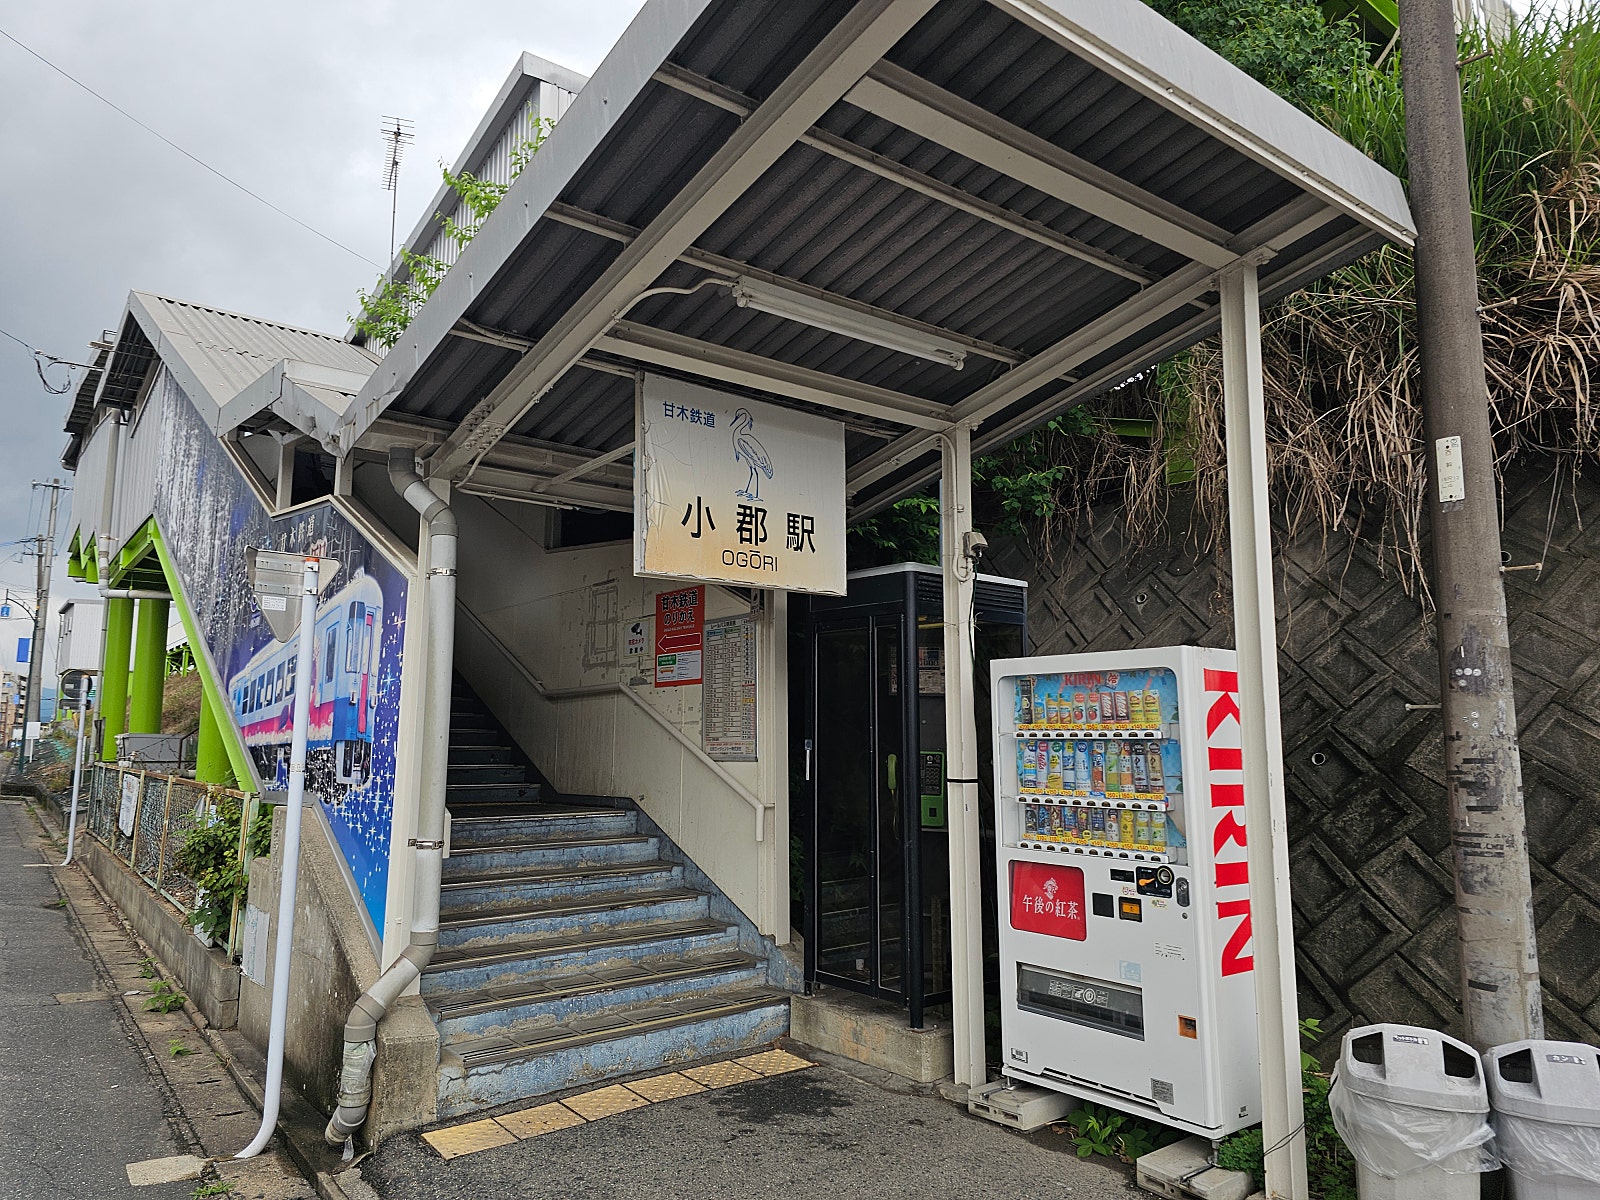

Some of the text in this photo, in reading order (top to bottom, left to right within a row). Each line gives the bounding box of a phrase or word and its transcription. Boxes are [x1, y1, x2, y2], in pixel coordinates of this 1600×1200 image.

[662, 400, 716, 428] 甘木鉄道
[680, 495, 816, 554] 小郡駅
[721, 549, 778, 572] OGŌRI
[661, 589, 699, 611] 甘木鉄道
[663, 608, 695, 625] のりかえ
[1064, 672, 1101, 687] KIRIN
[1101, 694, 1112, 717] Mets
[1115, 693, 1128, 717] Mets
[1203, 668, 1255, 977] KIRIN
[1022, 894, 1079, 920] 午後の紅茶
